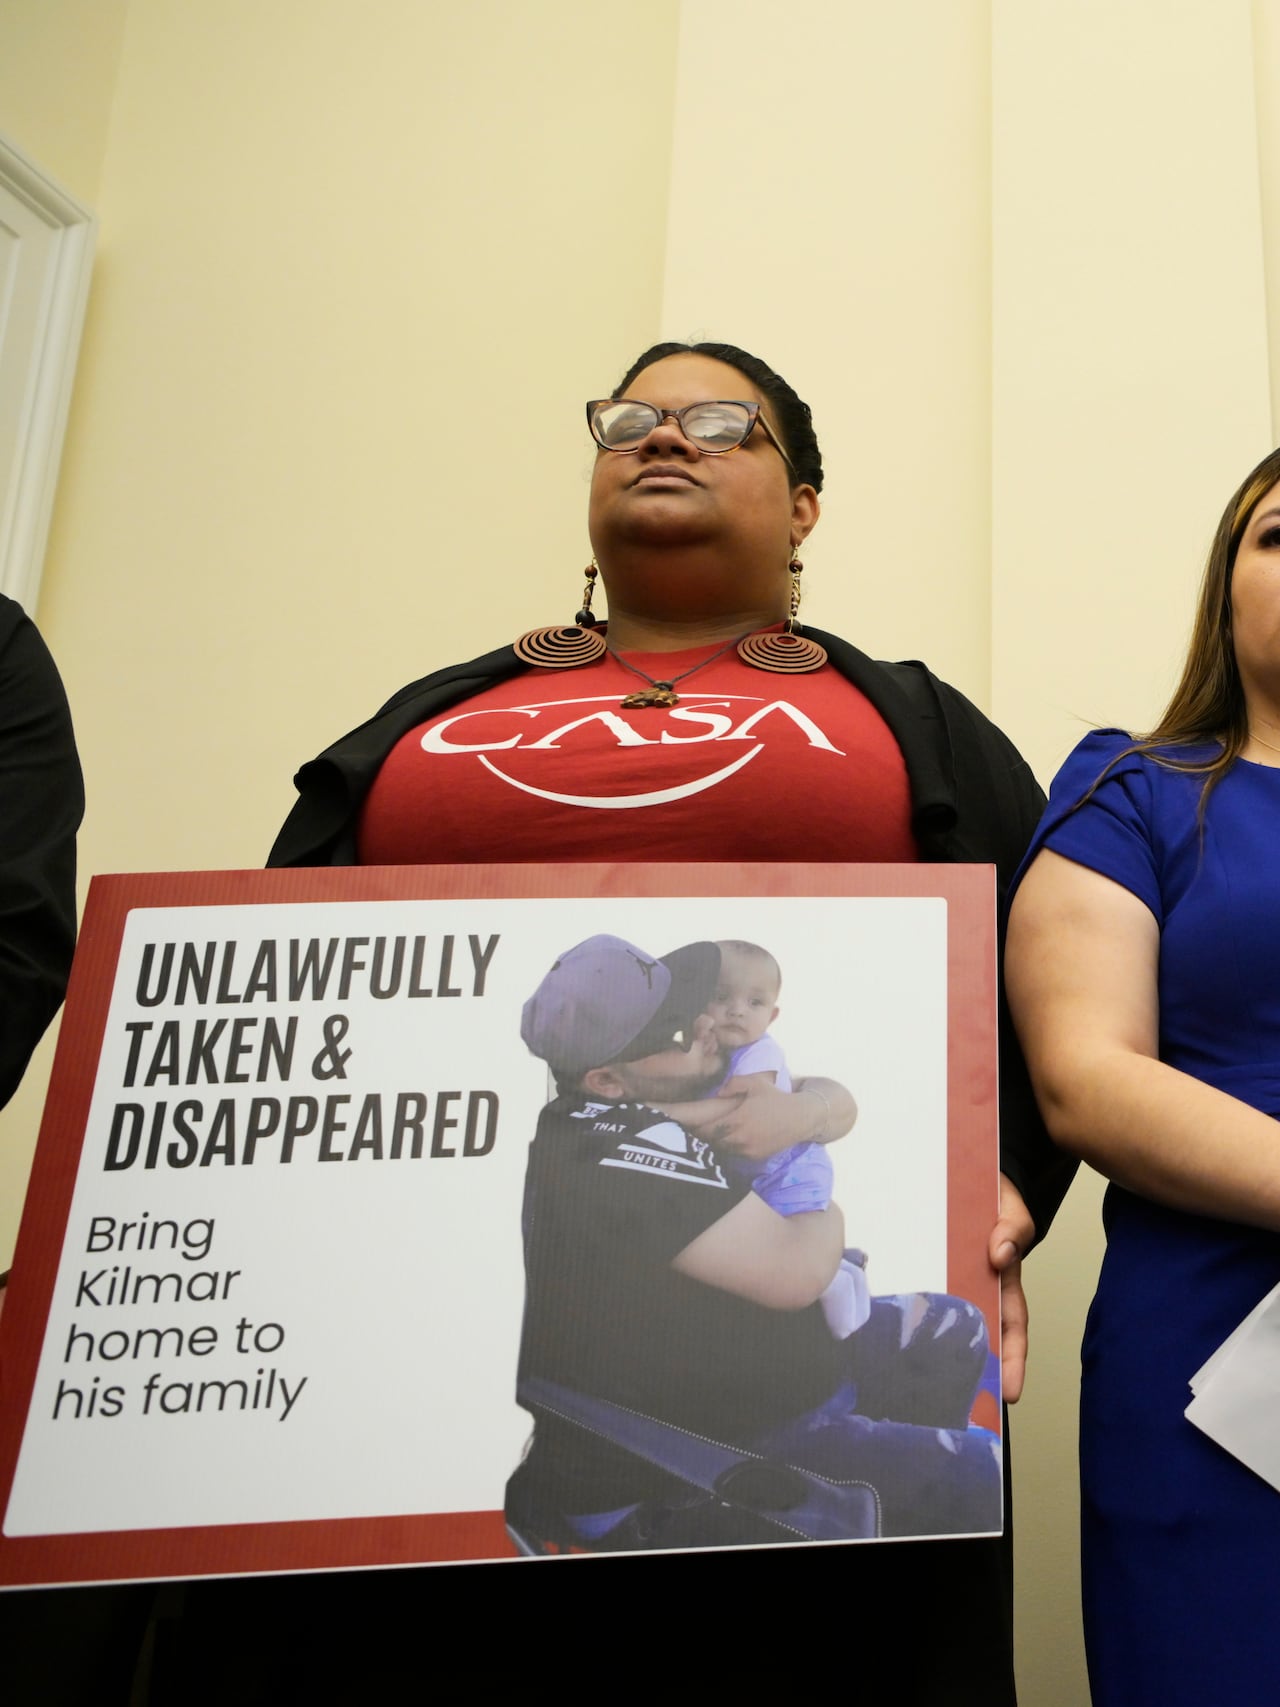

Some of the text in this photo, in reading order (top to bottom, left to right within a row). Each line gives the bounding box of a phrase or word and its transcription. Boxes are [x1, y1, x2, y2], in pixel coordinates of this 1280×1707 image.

[420, 700, 847, 756] CASA
[134, 934, 501, 1008] UNLAWFULLY
[121, 1013, 353, 1089] TAKEN &
[102, 1090, 500, 1172] DISAPPEARED
[592, 1121, 628, 1134] THAT
[623, 1150, 678, 1172] UNITES
[85, 1211, 216, 1261] Bring
[74, 1265, 241, 1308] Kilmar
[62, 1317, 286, 1364] home to
[51, 1368, 308, 1422] his family
